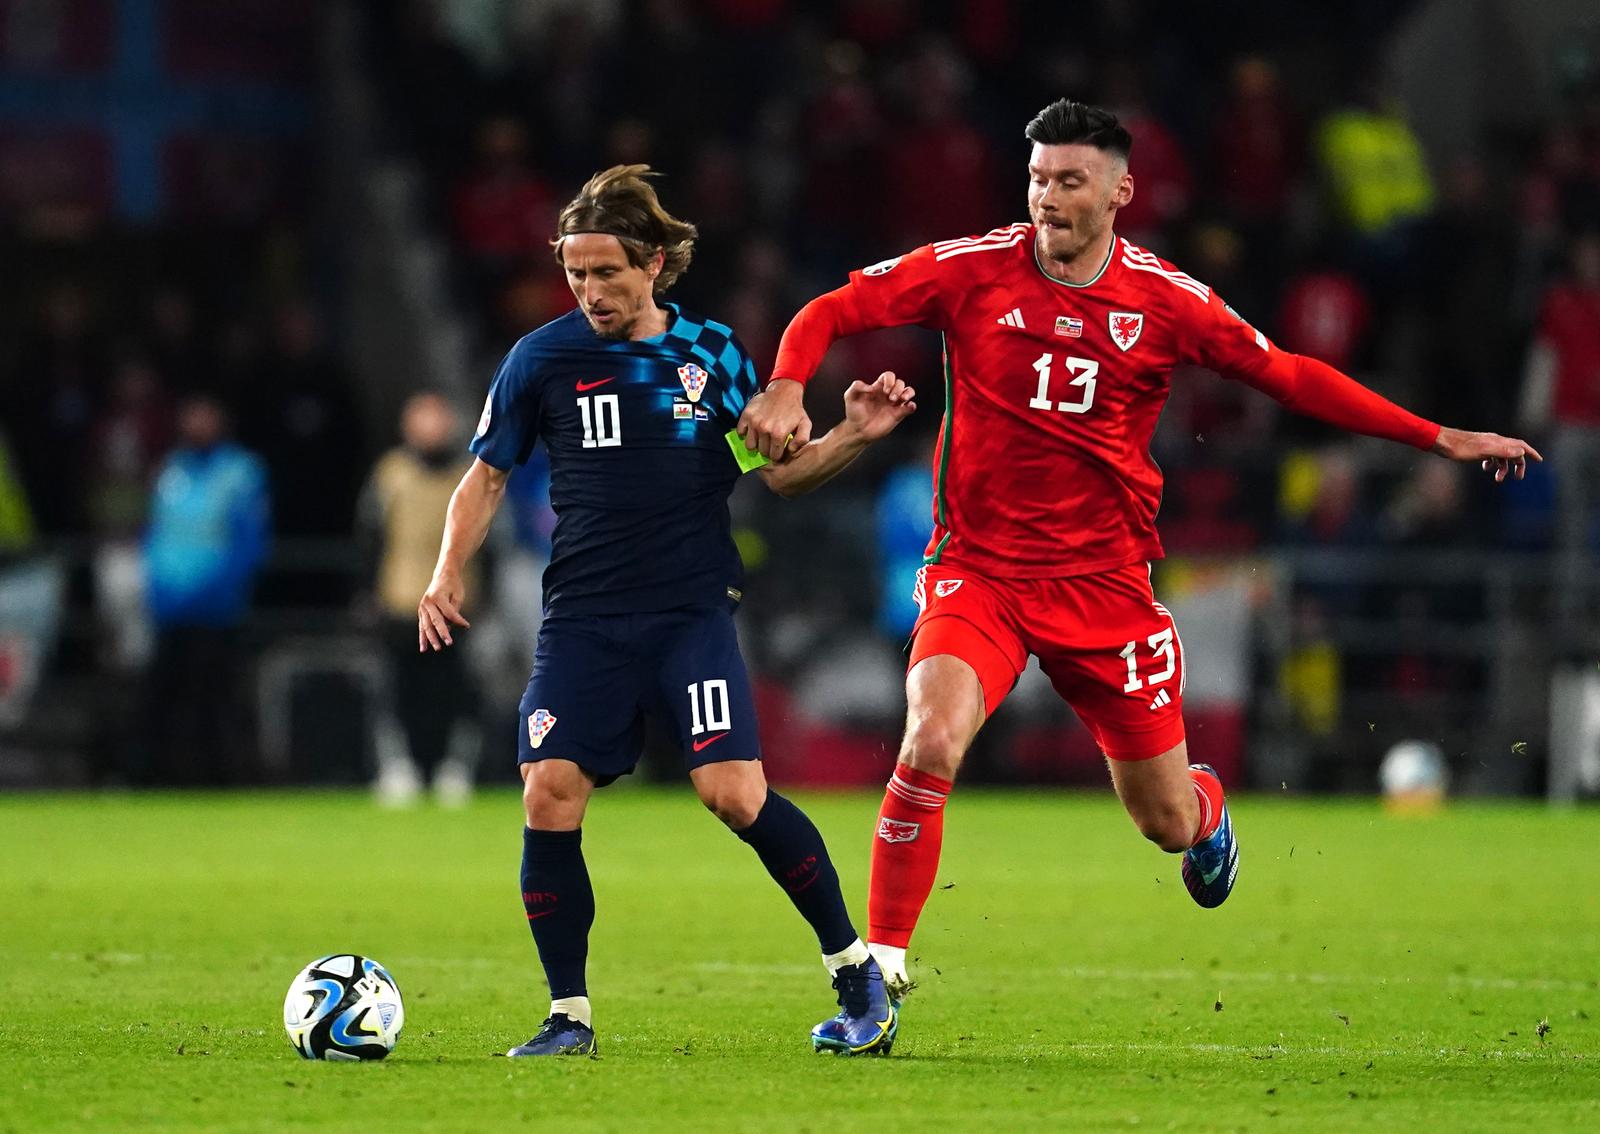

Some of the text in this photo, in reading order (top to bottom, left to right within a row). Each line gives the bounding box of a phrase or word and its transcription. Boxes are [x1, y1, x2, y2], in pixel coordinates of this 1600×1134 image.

[1029, 352, 1099, 414] 13
[576, 394, 622, 449] 10
[1118, 627, 1175, 694] 13
[687, 679, 731, 736] 10
